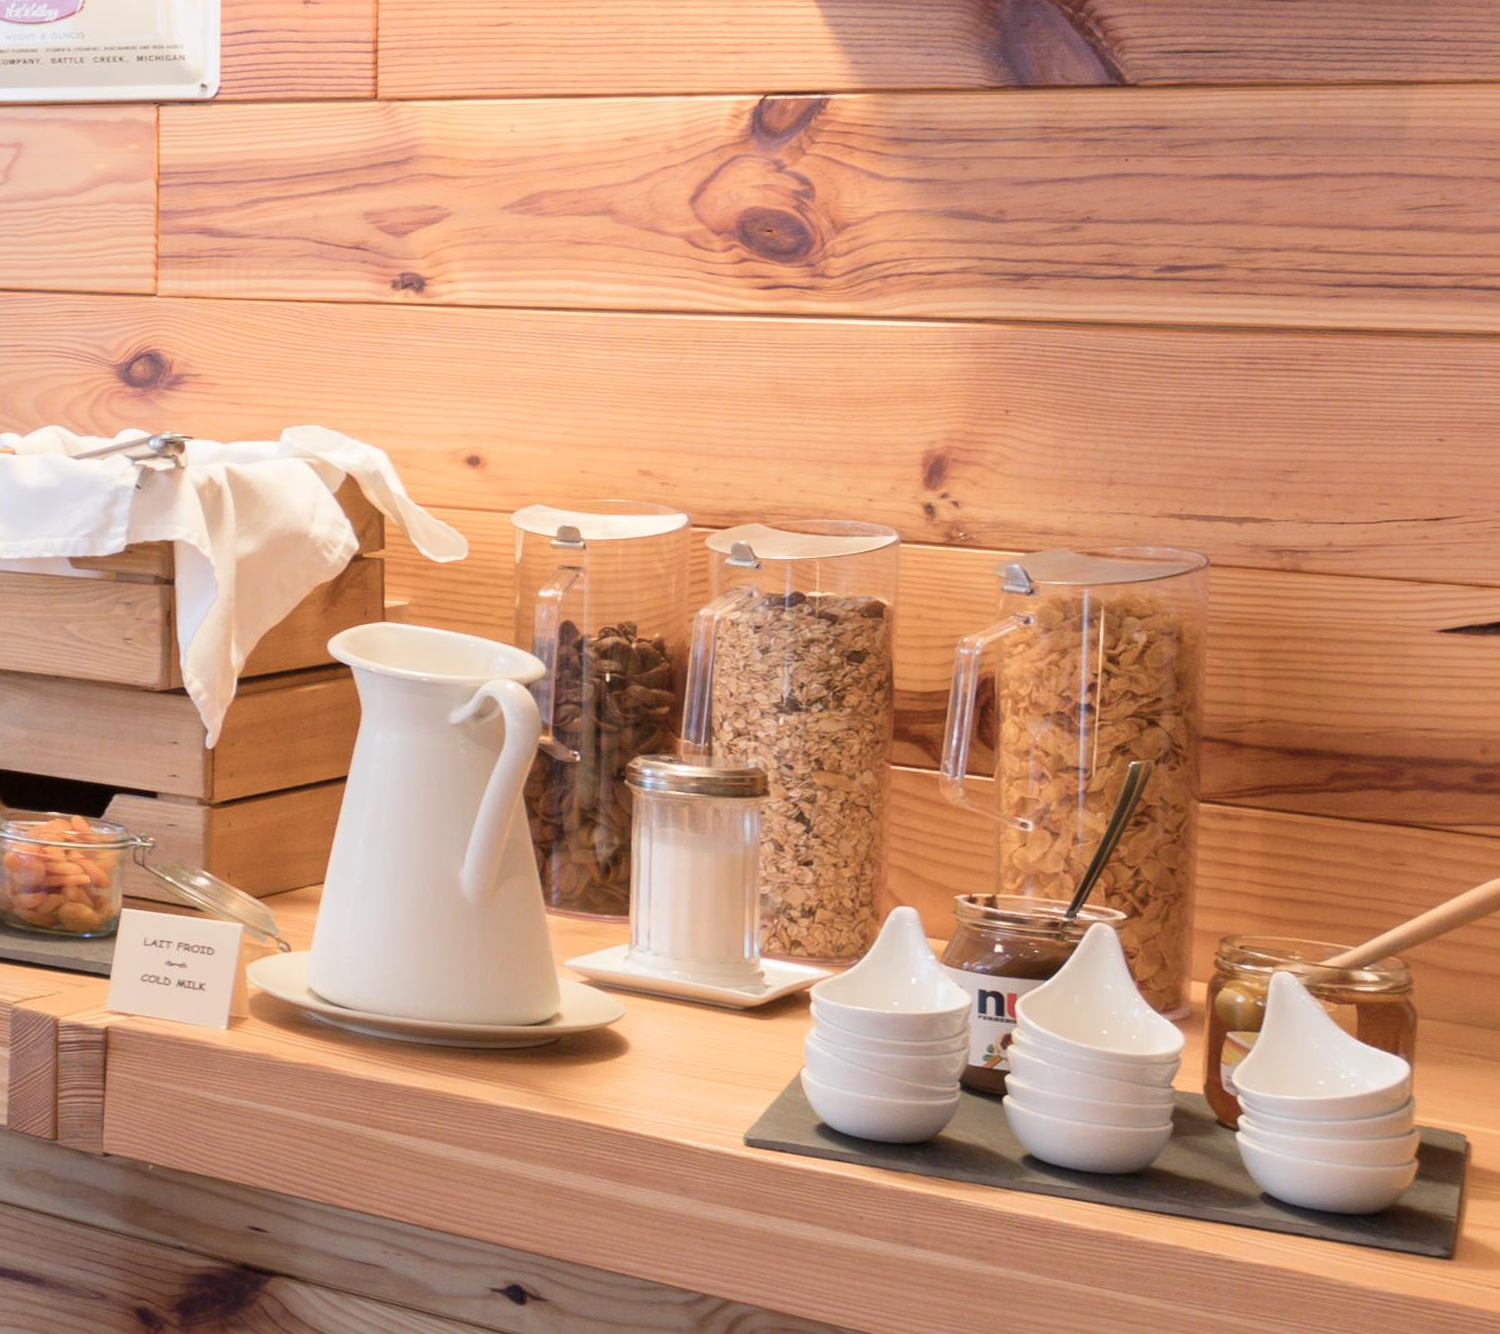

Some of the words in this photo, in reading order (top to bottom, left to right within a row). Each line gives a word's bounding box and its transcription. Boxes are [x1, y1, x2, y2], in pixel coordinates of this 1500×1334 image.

[50, 56, 85, 64] BATTLE
[136, 53, 186, 62] MICHIGAN
[143, 937, 173, 950] LAIT
[176, 941, 215, 956] FROID
[140, 973, 171, 987] COLD
[176, 979, 206, 992] MILK
